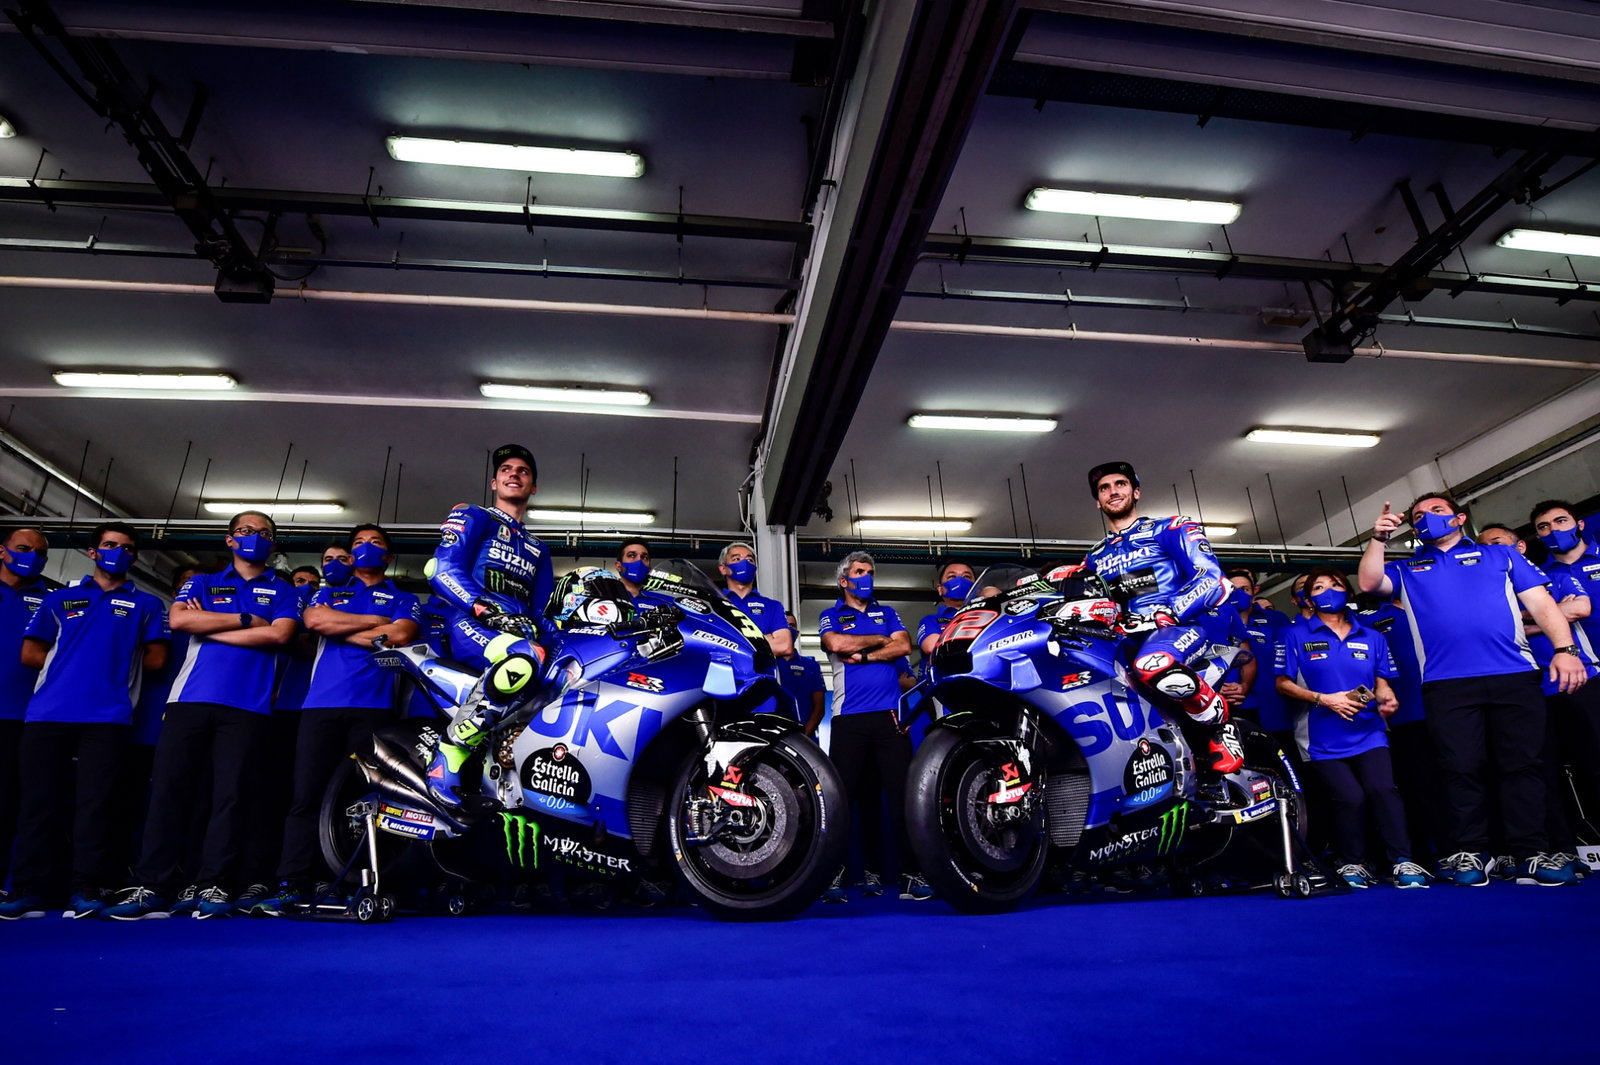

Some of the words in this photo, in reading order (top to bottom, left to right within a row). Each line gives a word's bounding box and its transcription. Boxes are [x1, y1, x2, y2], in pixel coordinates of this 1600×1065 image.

[491, 540, 515, 553] Team
[1096, 547, 1151, 573] SUZUKI
[1176, 577, 1216, 613] ECSTAR
[568, 628, 608, 636] SUZUKI
[690, 629, 739, 653] ECSTAR
[988, 630, 1035, 652] ECSTAR
[532, 756, 580, 783] Estrella
[1133, 753, 1166, 775] Estrella
[531, 772, 575, 797] Galicia
[1135, 769, 1168, 789] Galicia
[405, 811, 433, 823] MOTUL
[389, 822, 429, 836] MICHELIN
[543, 835, 632, 872] MONSTER
[1089, 826, 1159, 860] MONSTER
